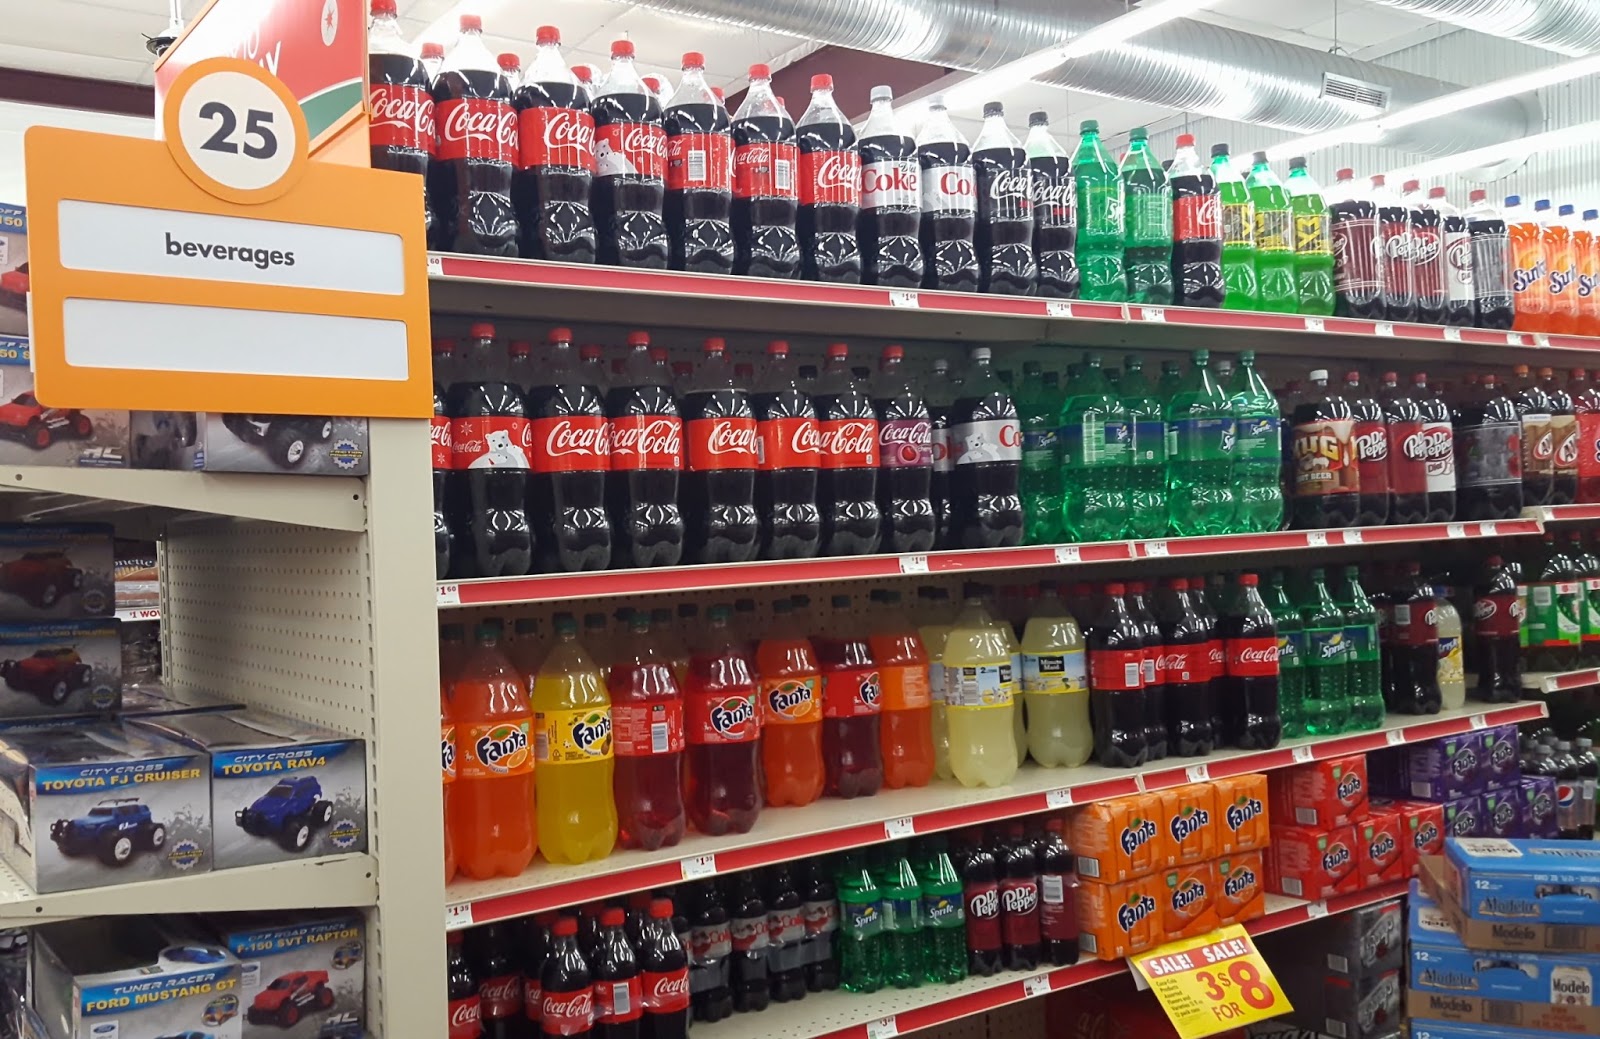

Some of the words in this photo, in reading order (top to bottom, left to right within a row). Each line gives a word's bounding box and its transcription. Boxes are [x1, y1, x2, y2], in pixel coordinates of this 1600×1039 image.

[199, 102, 278, 159] 25
[861, 169, 917, 195] Coke
[165, 232, 295, 270] beverages
[879, 421, 932, 446] Coca-Cola
[1251, 423, 1273, 436] Sprite
[1370, 431, 1383, 443] Dr
[769, 684, 811, 713] Fanta
[710, 700, 754, 733] Fanta
[572, 717, 611, 749] Fanta
[234, 753, 266, 763] CITY
[267, 750, 313, 761] CROSS
[475, 730, 527, 767] Fanta
[80, 767, 113, 777] CITY
[115, 763, 164, 774] CROSS
[222, 760, 282, 775] TOYOTA
[287, 756, 326, 769] RAV4
[42, 777, 105, 791] TOYOTA
[111, 775, 128, 785] FJ
[134, 768, 201, 783] CRUISER
[1337, 777, 1361, 799] Fanta
[1170, 808, 1209, 843] Fanta
[1226, 798, 1262, 831] Fanta
[1121, 819, 1156, 856] Fanta
[1369, 833, 1396, 857] Fanta
[1413, 825, 1440, 848] Fanta
[1322, 848, 1350, 872] Fanta
[1018, 887, 1031, 898] Dr
[1224, 869, 1255, 897] Fanta
[1474, 880, 1491, 889] 12
[1001, 889, 1038, 913] Pepper
[1172, 882, 1205, 910] Fanta
[854, 911, 878, 928] Sprite
[929, 903, 954, 919] Sprite
[1118, 895, 1155, 933] Fanta
[237, 941, 273, 953] F-150
[277, 936, 303, 948] SVT
[306, 928, 359, 944] RAPTOR
[1492, 924, 1536, 940] Modelo
[1150, 954, 1194, 976] SALE!
[1202, 939, 1248, 963] SALE!
[1414, 952, 1429, 961] 12
[86, 997, 130, 1012] FORD
[135, 983, 211, 1004] MUSTANG
[216, 979, 237, 992] GT
[114, 981, 163, 995] TUNER
[165, 972, 216, 987] RACER
[1196, 971, 1225, 1001] 3
[1552, 978, 1591, 994] Modelo
[543, 991, 593, 1018] Coca-Cola
[1212, 1001, 1245, 1022] FOR
[1430, 996, 1472, 1012] Modelo
